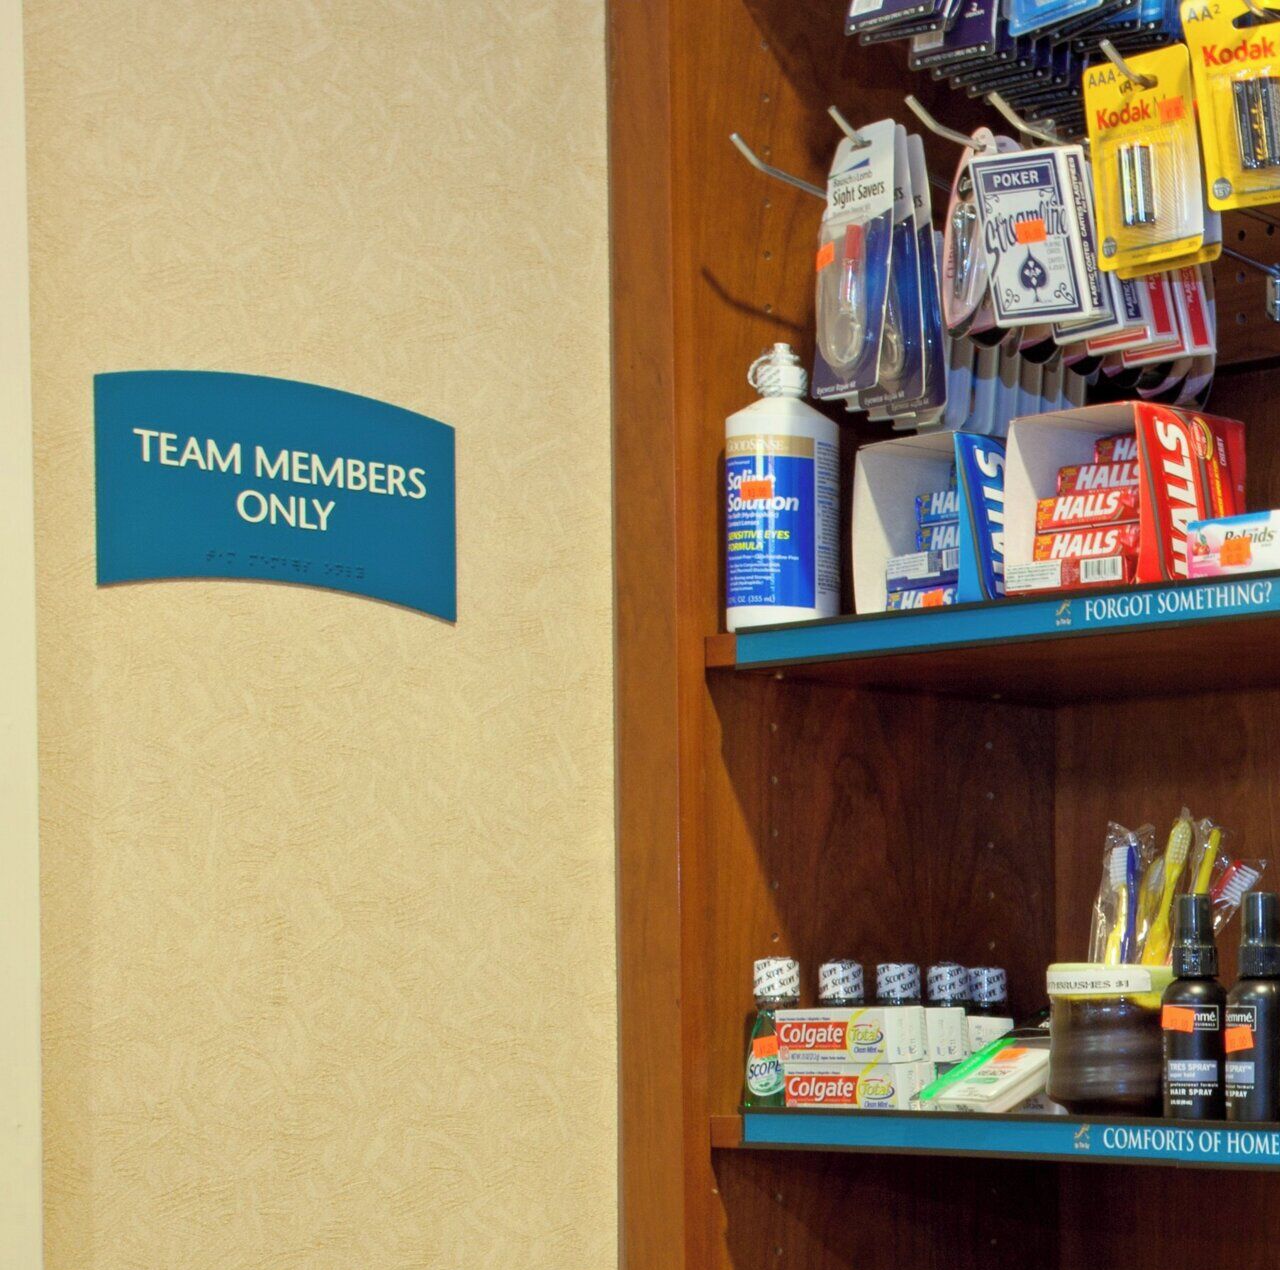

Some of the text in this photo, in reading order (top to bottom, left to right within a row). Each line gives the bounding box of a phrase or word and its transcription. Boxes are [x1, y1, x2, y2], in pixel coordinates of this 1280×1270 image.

[1202, 37, 1276, 67] Kodak
[1096, 99, 1150, 129] Kodak
[992, 170, 1039, 187] POKER
[833, 181, 886, 206] Sight Savers
[133, 428, 427, 499] TEAM MEMBERS
[1216, 436, 1227, 466] CHERRY
[236, 489, 336, 531] ONLY
[1052, 492, 1121, 521] HALLS
[764, 530, 790, 539] EYES
[1050, 530, 1119, 559] HALLS
[1085, 582, 1272, 621] FORGOT SOMETHING?
[779, 1023, 844, 1051] Colgate
[851, 1024, 881, 1045] Total
[749, 1058, 781, 1079] SCOPE
[788, 1077, 855, 1102] Colgate
[861, 1079, 892, 1099] Total
[1170, 1088, 1212, 1096] HAIR SPRAY
[1104, 1127, 1280, 1155] COMFORTS OF HOME
